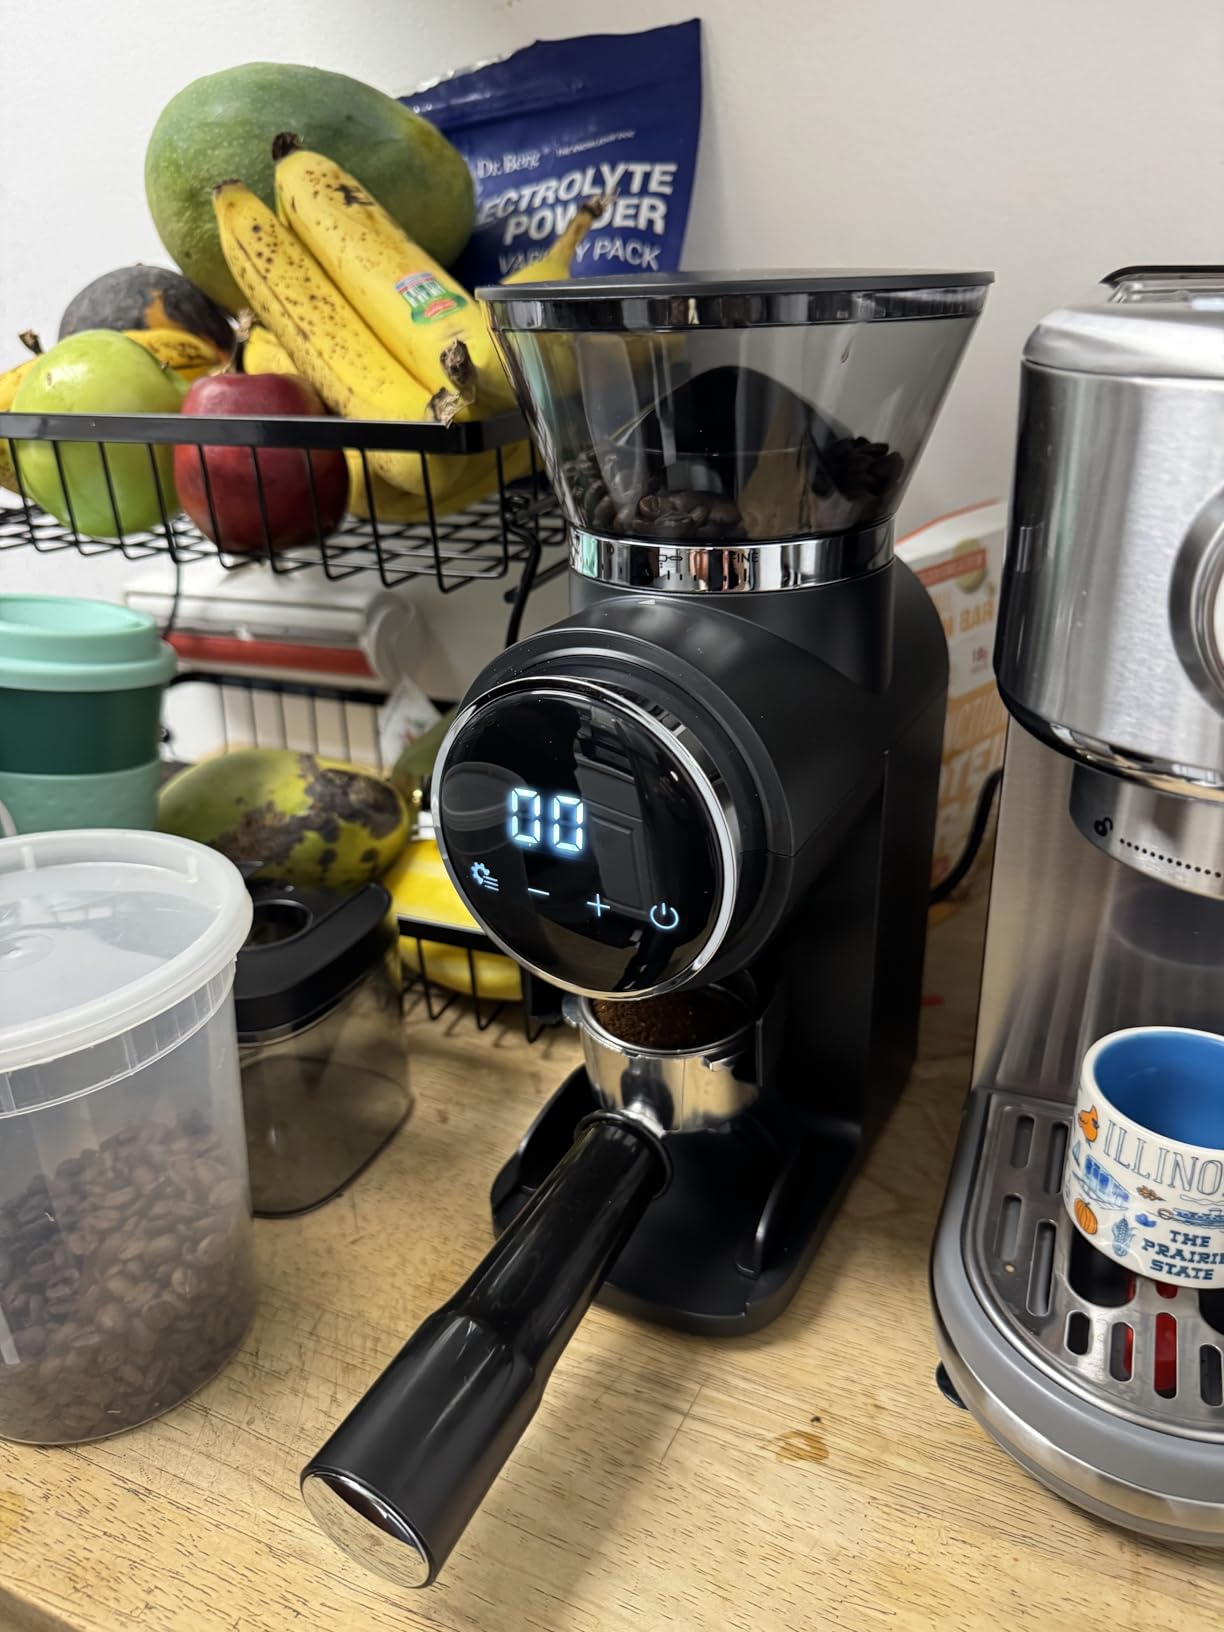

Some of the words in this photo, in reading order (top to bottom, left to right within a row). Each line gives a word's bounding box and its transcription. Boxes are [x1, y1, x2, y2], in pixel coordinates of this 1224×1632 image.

[476, 162, 678, 225] ECTROLYTE
[593, 236, 661, 272] PACK
[510, 787, 584, 852] 00
[1102, 1118, 1224, 1197] ILLINO
[1169, 1229, 1212, 1248] THE
[1149, 1258, 1215, 1281] STATE
